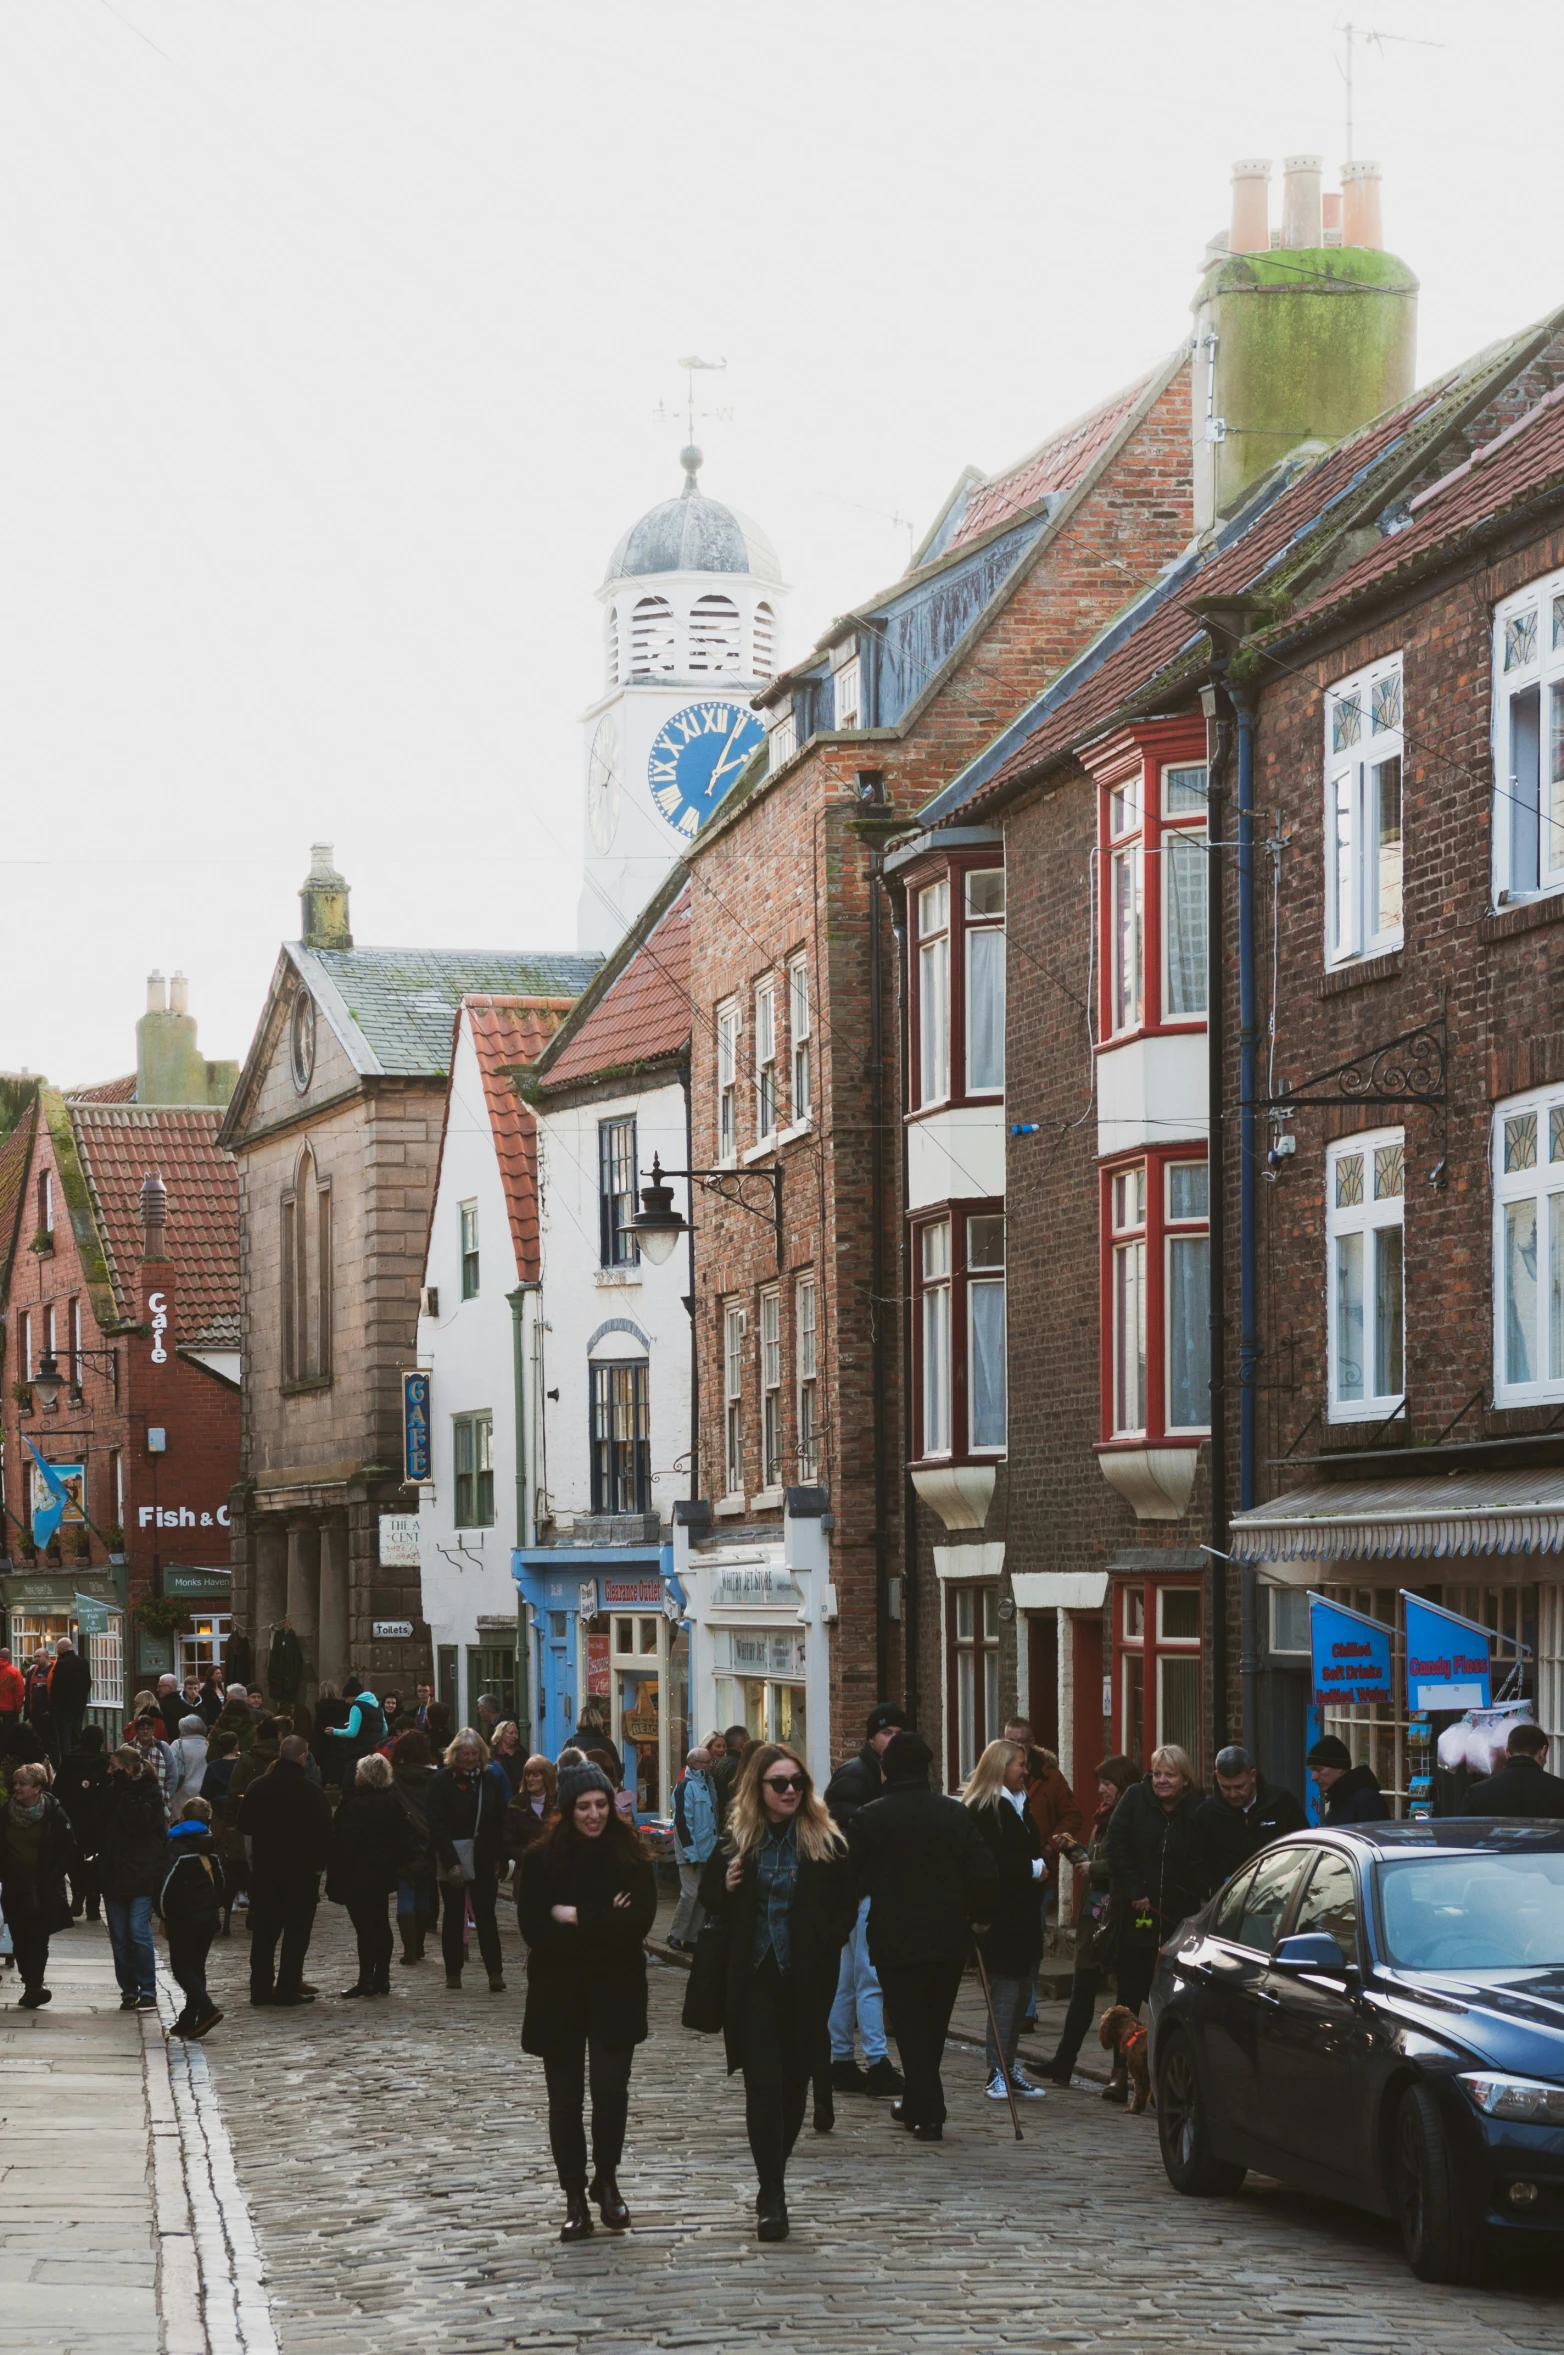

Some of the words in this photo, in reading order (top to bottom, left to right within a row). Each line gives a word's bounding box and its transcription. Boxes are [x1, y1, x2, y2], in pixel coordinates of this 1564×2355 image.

[674, 713, 702, 744] XI
[701, 708, 729, 734] XII
[659, 734, 684, 759] X
[653, 759, 677, 782] IX
[657, 784, 683, 816] VIII
[148, 1292, 168, 1364] Cafe
[138, 1506, 196, 1528] Fish
[199, 1511, 215, 1527] &
[389, 1520, 410, 1531] THE
[175, 1578, 202, 1587] Monks
[203, 1578, 230, 1587] Haven
[604, 1579, 637, 1602] Clearance
[639, 1579, 661, 1602] Outlet
[721, 1569, 742, 1591] WHITBY
[743, 1569, 753, 1591] JET
[754, 1569, 772, 1591] STORE
[86, 1625, 102, 1633] Chips
[376, 1625, 408, 1634] Toilets
[1332, 1641, 1372, 1658] Chilled
[1322, 1665, 1345, 1681] Soft
[1346, 1664, 1382, 1680] Drinks
[1409, 1656, 1451, 1680] Candy
[1453, 1655, 1488, 1675] Floss
[1356, 1686, 1391, 1701] Water
